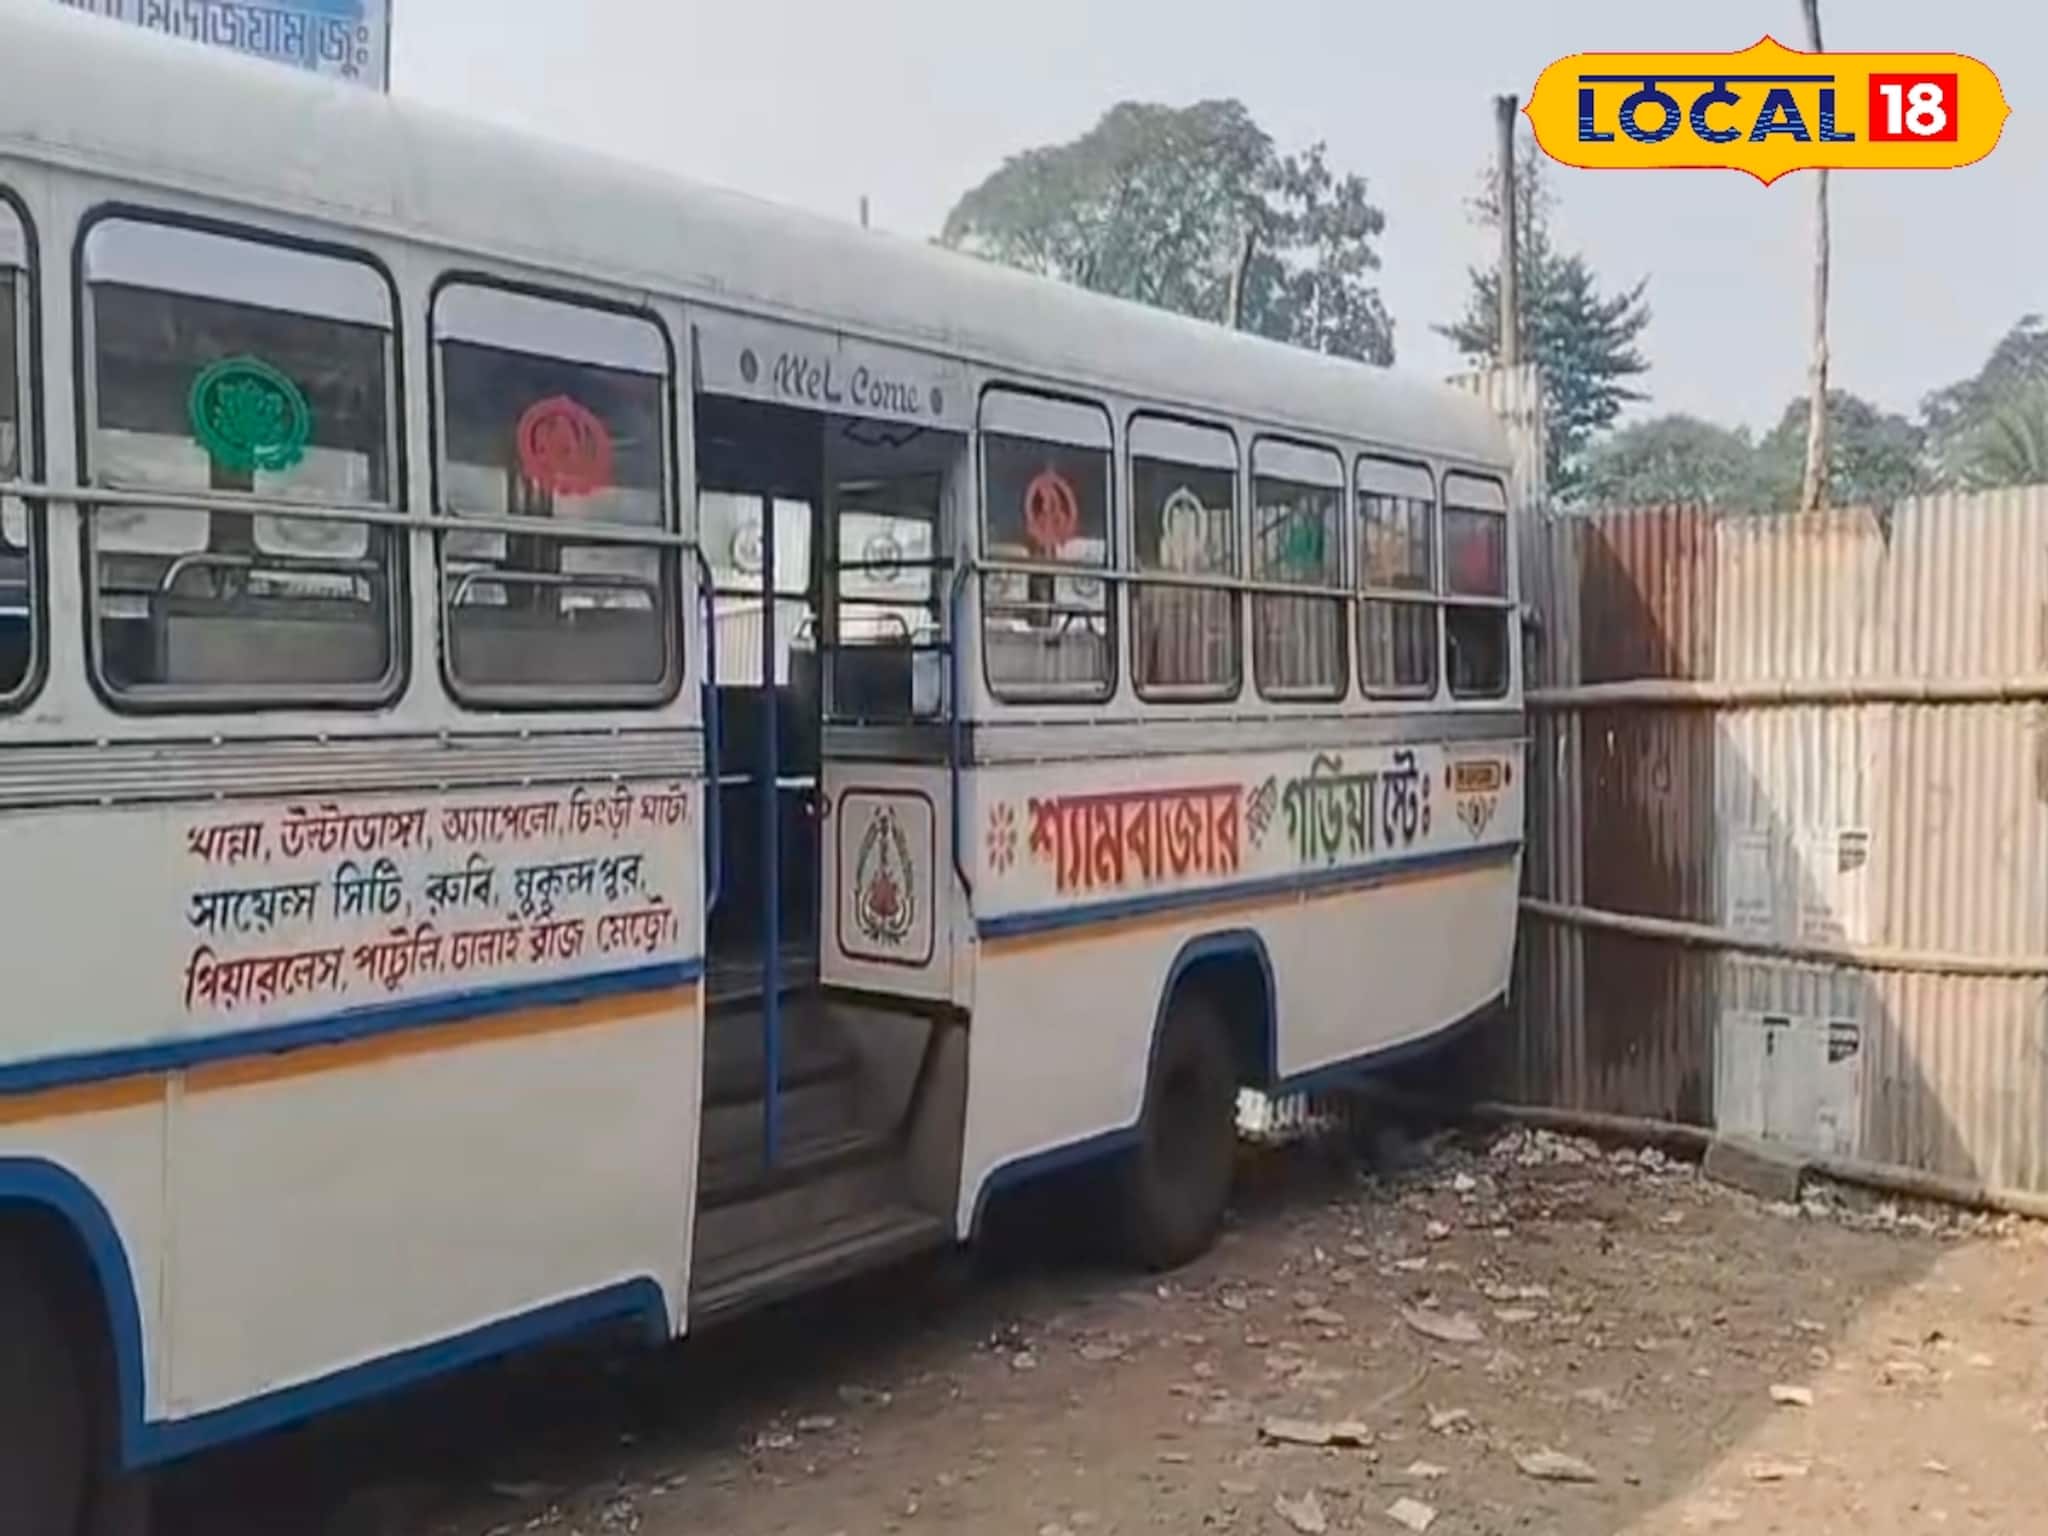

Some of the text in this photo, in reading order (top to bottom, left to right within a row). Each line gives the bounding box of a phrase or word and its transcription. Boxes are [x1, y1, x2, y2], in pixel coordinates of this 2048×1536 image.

[851, 366, 921, 414] Come
[1028, 784, 1243, 892] শ্যামবাজার
[1282, 752, 1378, 866] গড়িয়া
[187, 880, 321, 935] সায়েন্স
